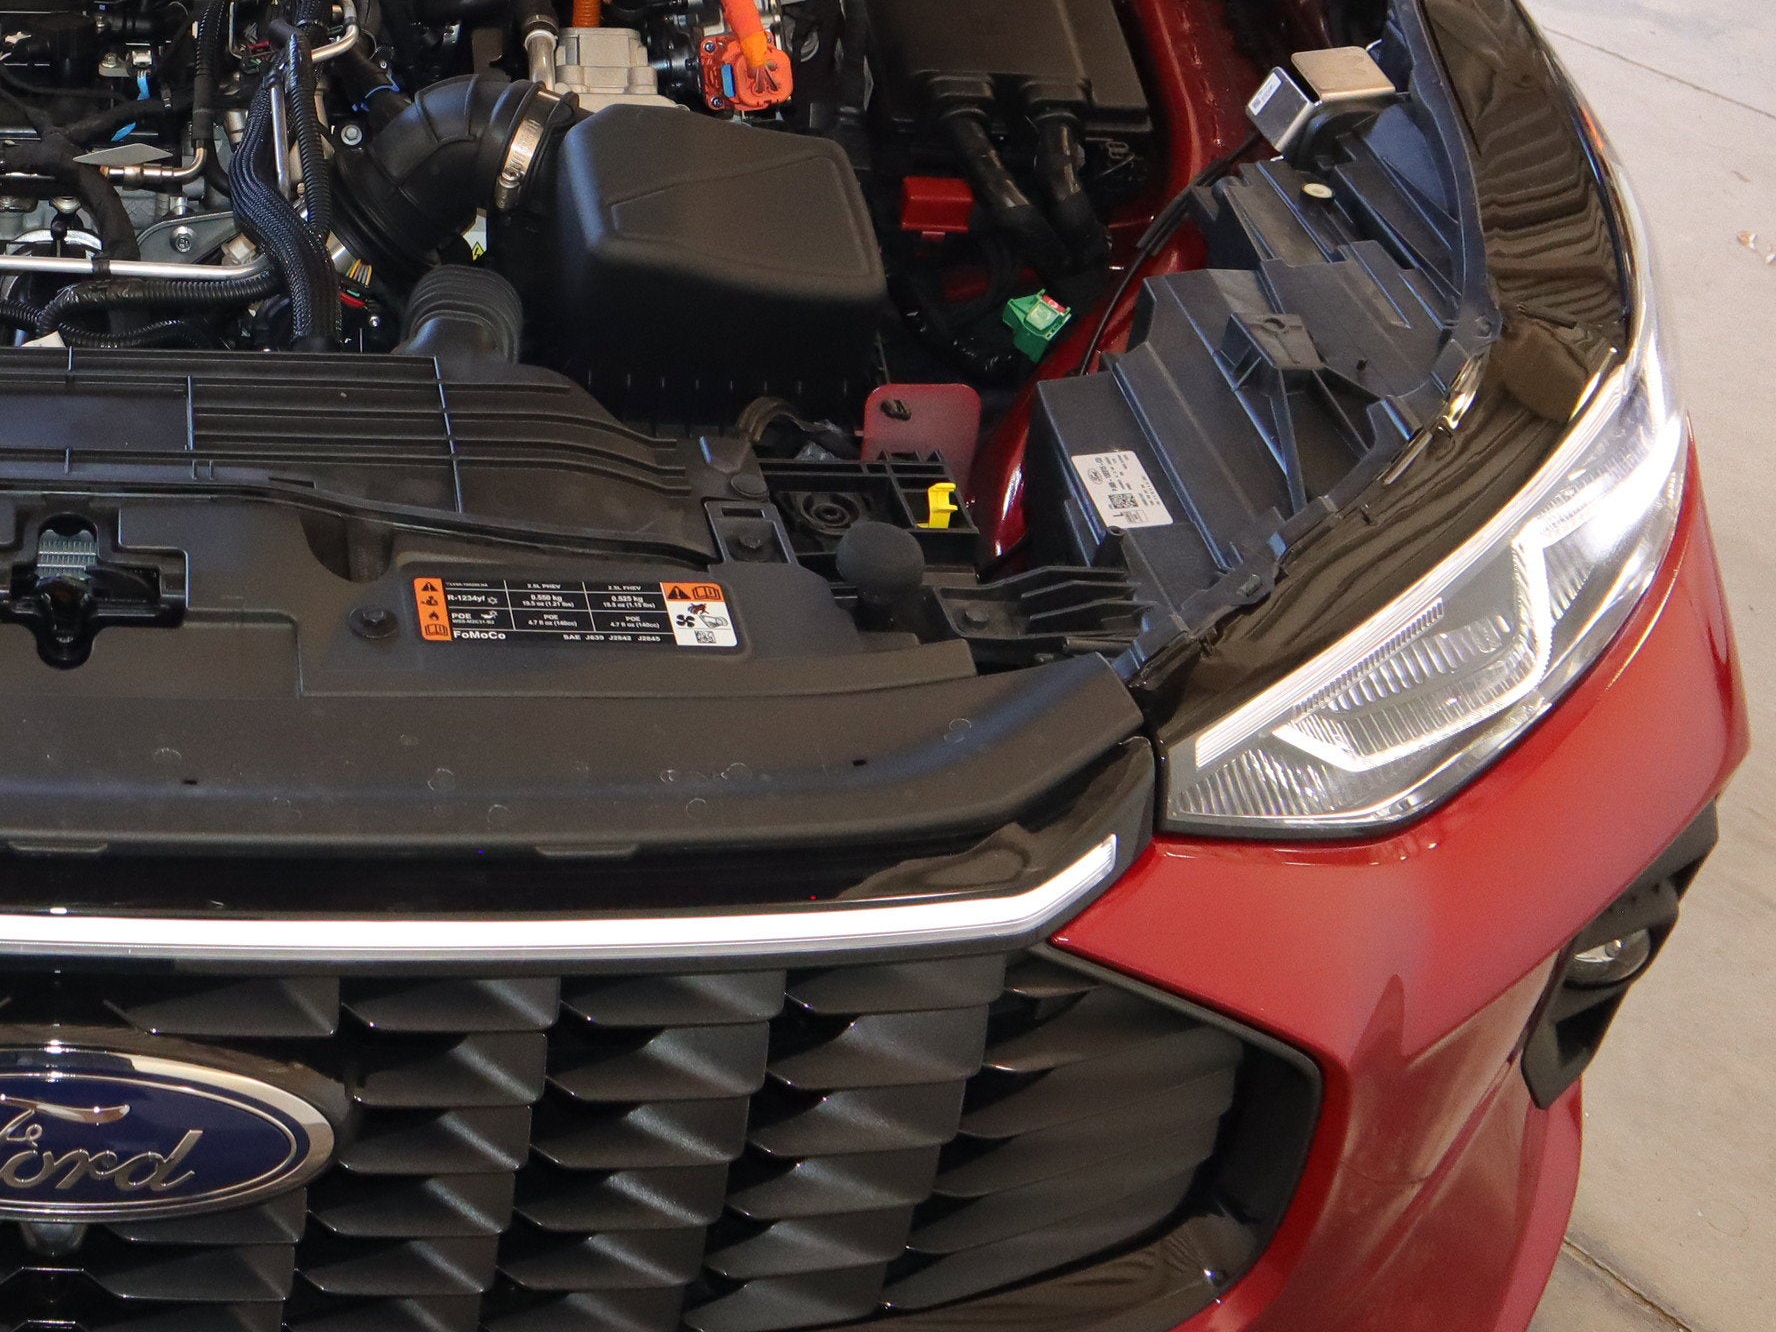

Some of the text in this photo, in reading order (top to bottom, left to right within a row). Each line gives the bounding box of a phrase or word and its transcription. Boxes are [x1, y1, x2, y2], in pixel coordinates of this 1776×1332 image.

[447, 594, 486, 602] R-1234yf
[551, 594, 563, 603] kg
[453, 630, 507, 639] FoMoCo
